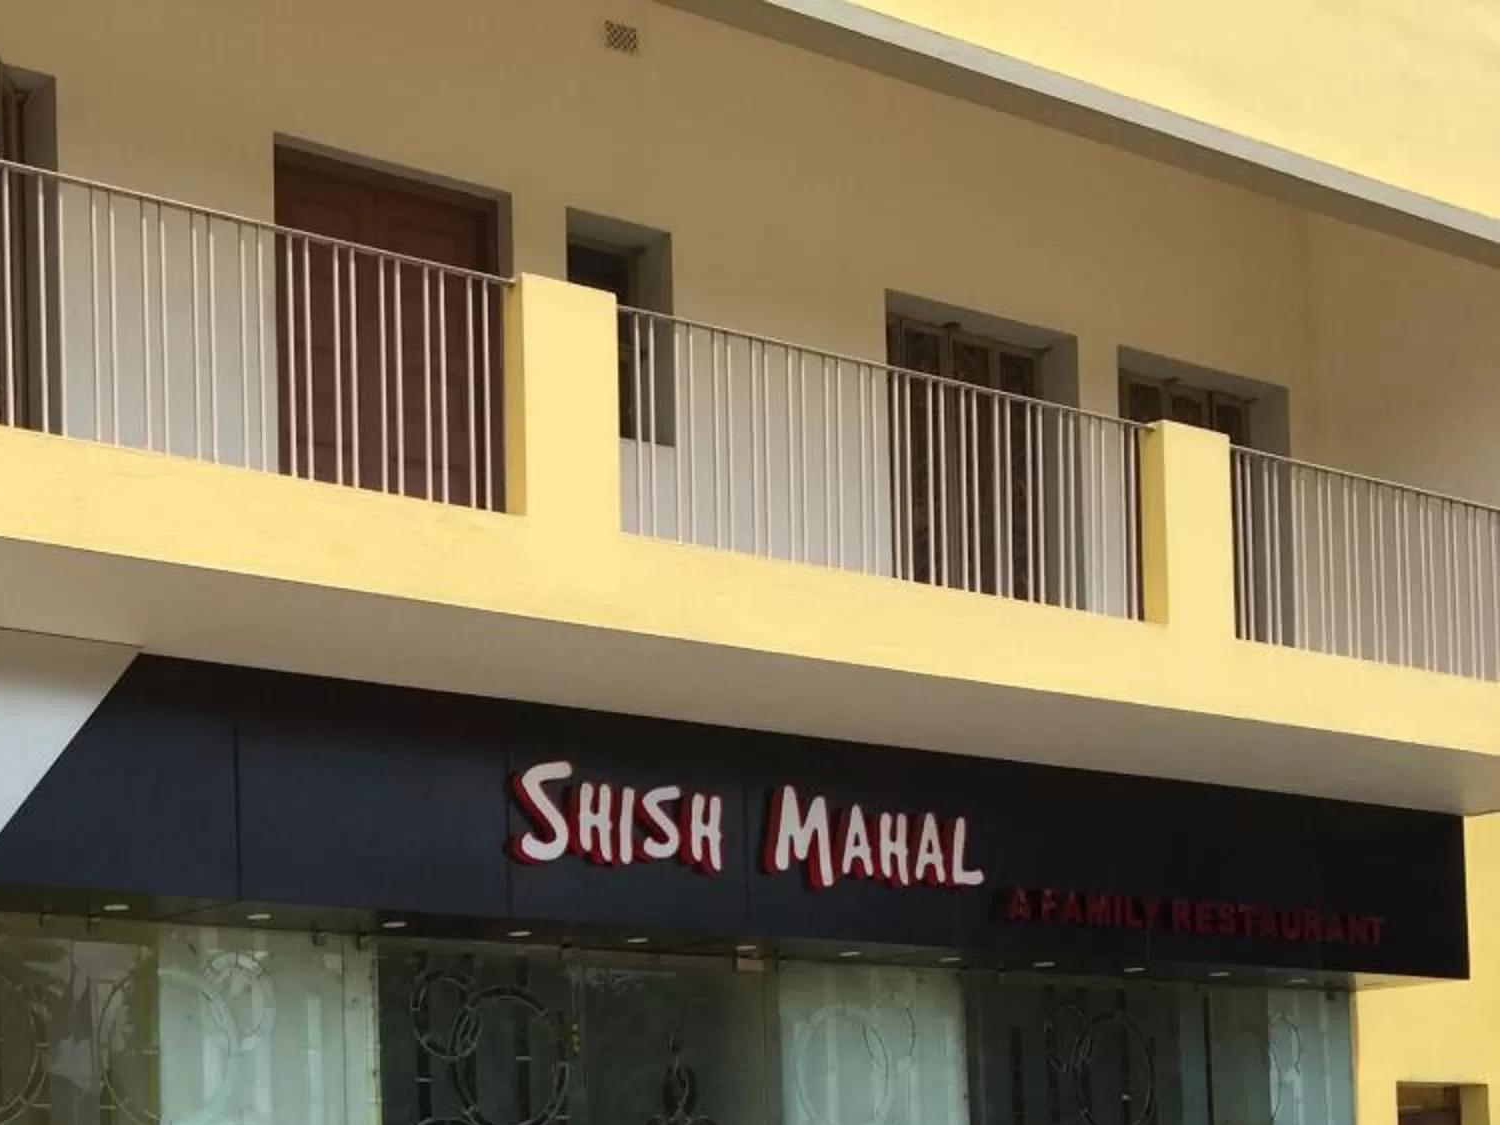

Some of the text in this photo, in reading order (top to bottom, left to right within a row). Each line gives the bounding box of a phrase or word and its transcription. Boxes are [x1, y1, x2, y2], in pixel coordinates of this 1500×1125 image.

[510, 761, 985, 888] SHISH MAHAL
[1005, 886, 1384, 947] A FAMILY RESTAURANT
